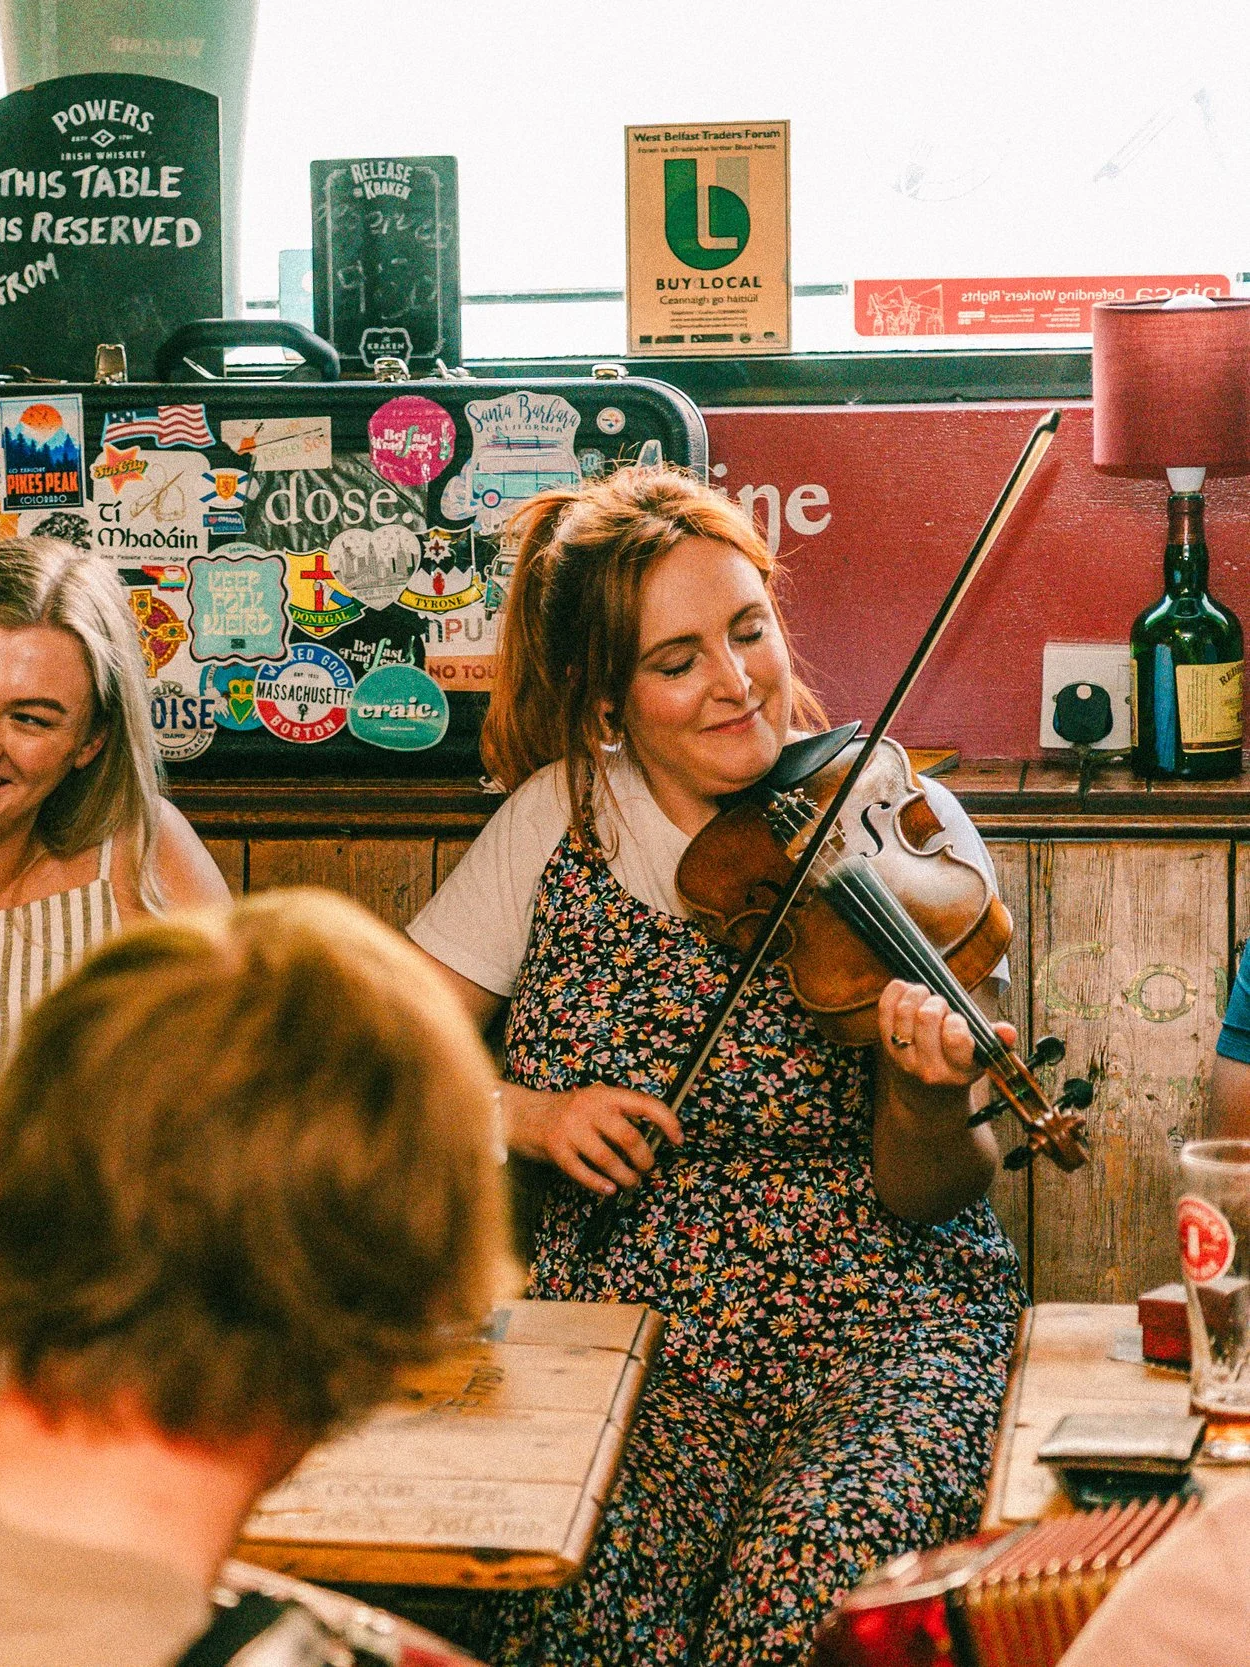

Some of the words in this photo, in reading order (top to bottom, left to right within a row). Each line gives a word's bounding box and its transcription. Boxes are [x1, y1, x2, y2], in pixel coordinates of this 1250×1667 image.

[51, 99, 155, 135] POWERS
[633, 132, 661, 142] West
[664, 132, 700, 141] Belfast
[702, 130, 742, 140] Traders
[744, 129, 780, 139] Forum
[60, 152, 92, 161] IRISH
[96, 150, 146, 161] WHISKEY
[72, 165, 185, 199] TABLE
[351, 160, 413, 183] RELEASE
[363, 180, 412, 200] KRAKEN
[31, 211, 202, 248] RESERVED
[656, 277, 691, 291] BUY
[700, 275, 763, 290] LOCAL
[712, 297, 724, 306] go
[467, 402, 513, 433] Santa
[517, 393, 580, 430] Barbara
[383, 425, 437, 449] Belfast
[486, 424, 564, 434] CALIFORNIA
[117, 459, 148, 475] City
[6, 473, 43, 495] PIKES
[44, 471, 78, 493] PEAK
[20, 494, 68, 505] COLORADO
[97, 526, 199, 549] Mhadáin
[207, 570, 261, 592] KEEP
[414, 595, 465, 609] TYRONE
[202, 609, 274, 636] WEIRD
[291, 611, 351, 625] DONEGAL
[353, 638, 406, 663] Belfast
[321, 654, 350, 686] GOOD
[429, 664, 457, 689] NO
[151, 697, 216, 730] OISE
[269, 714, 337, 740] BOSTON
[159, 748, 182, 757] APPY
[183, 734, 206, 754] PLACE
